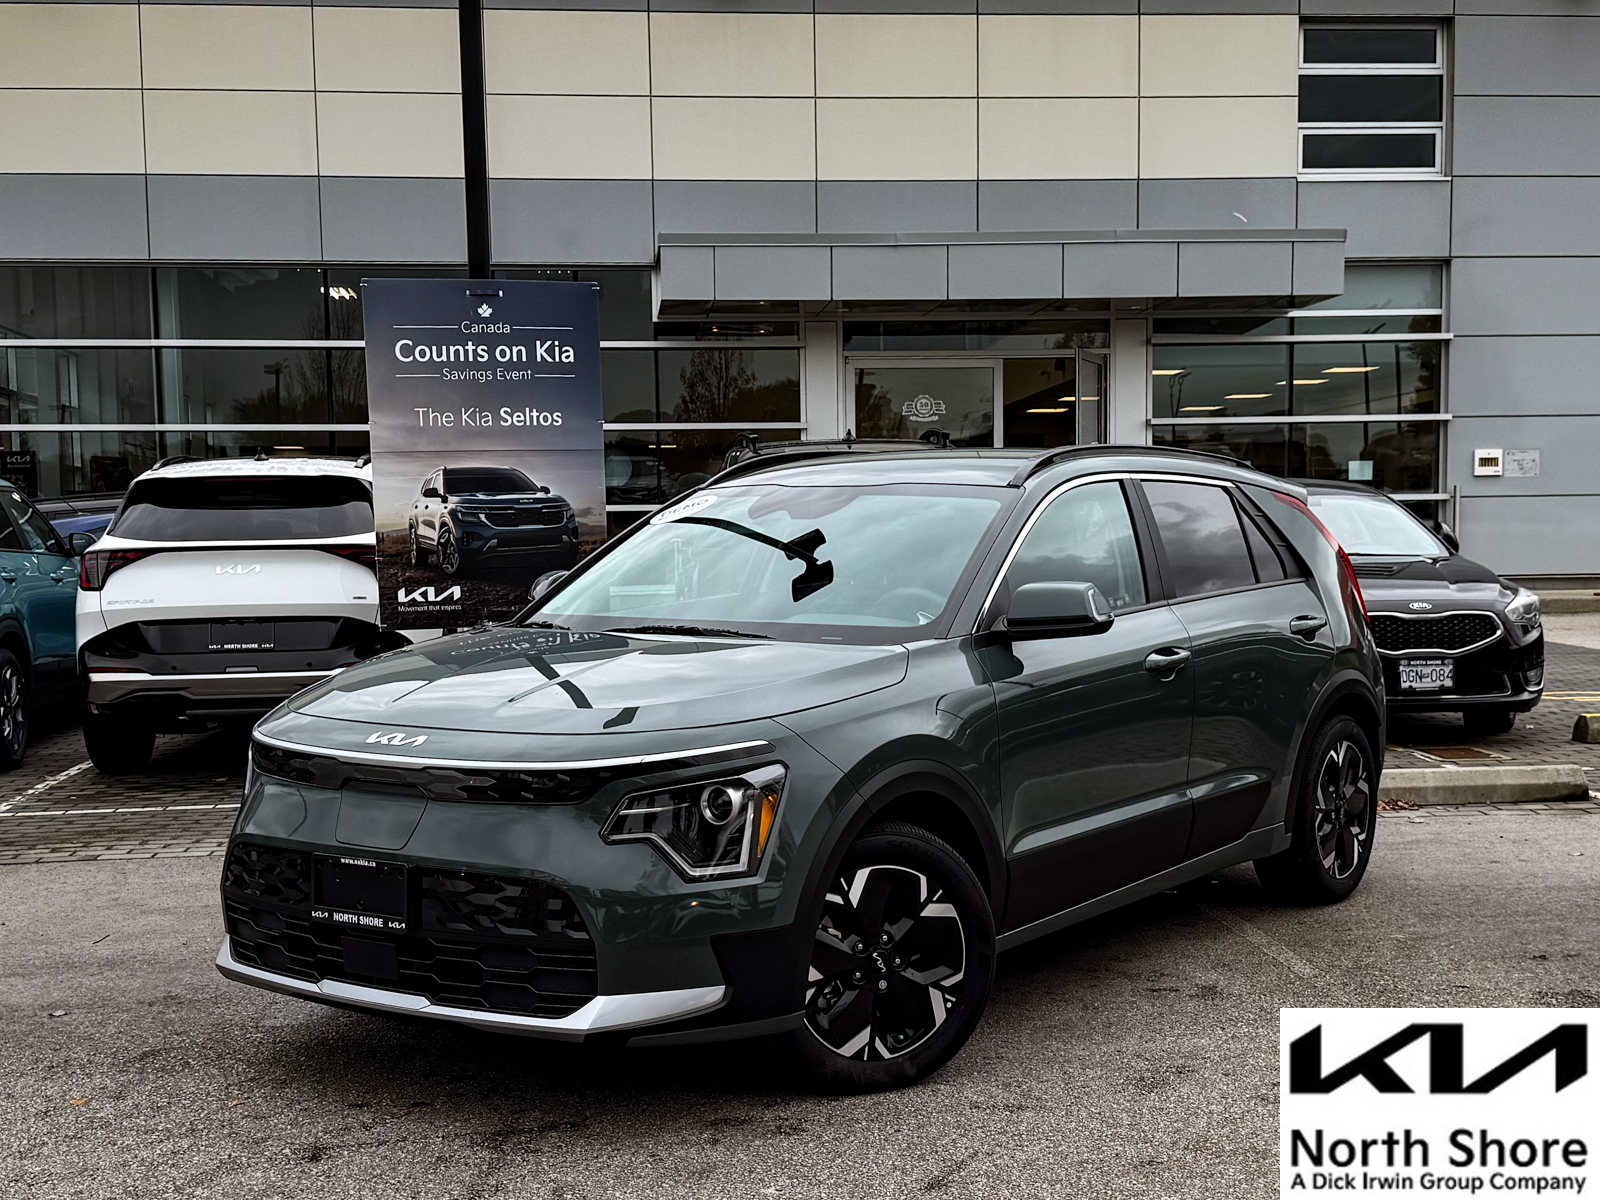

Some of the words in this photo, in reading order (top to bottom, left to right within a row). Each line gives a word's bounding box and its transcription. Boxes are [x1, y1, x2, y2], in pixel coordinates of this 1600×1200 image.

[461, 320, 511, 334] Canada
[394, 339, 489, 363] Counts
[495, 344, 527, 363] on
[535, 340, 575, 363] Kia
[442, 367, 493, 382] Savings
[497, 368, 532, 380] Event
[413, 407, 455, 427] The
[461, 407, 493, 427] Kia
[499, 407, 563, 426] Seltos
[215, 563, 262, 575] KIA
[397, 585, 462, 603] KIA
[364, 731, 429, 747] KIA
[333, 912, 358, 924] NORTH
[359, 916, 384, 928] SHORE
